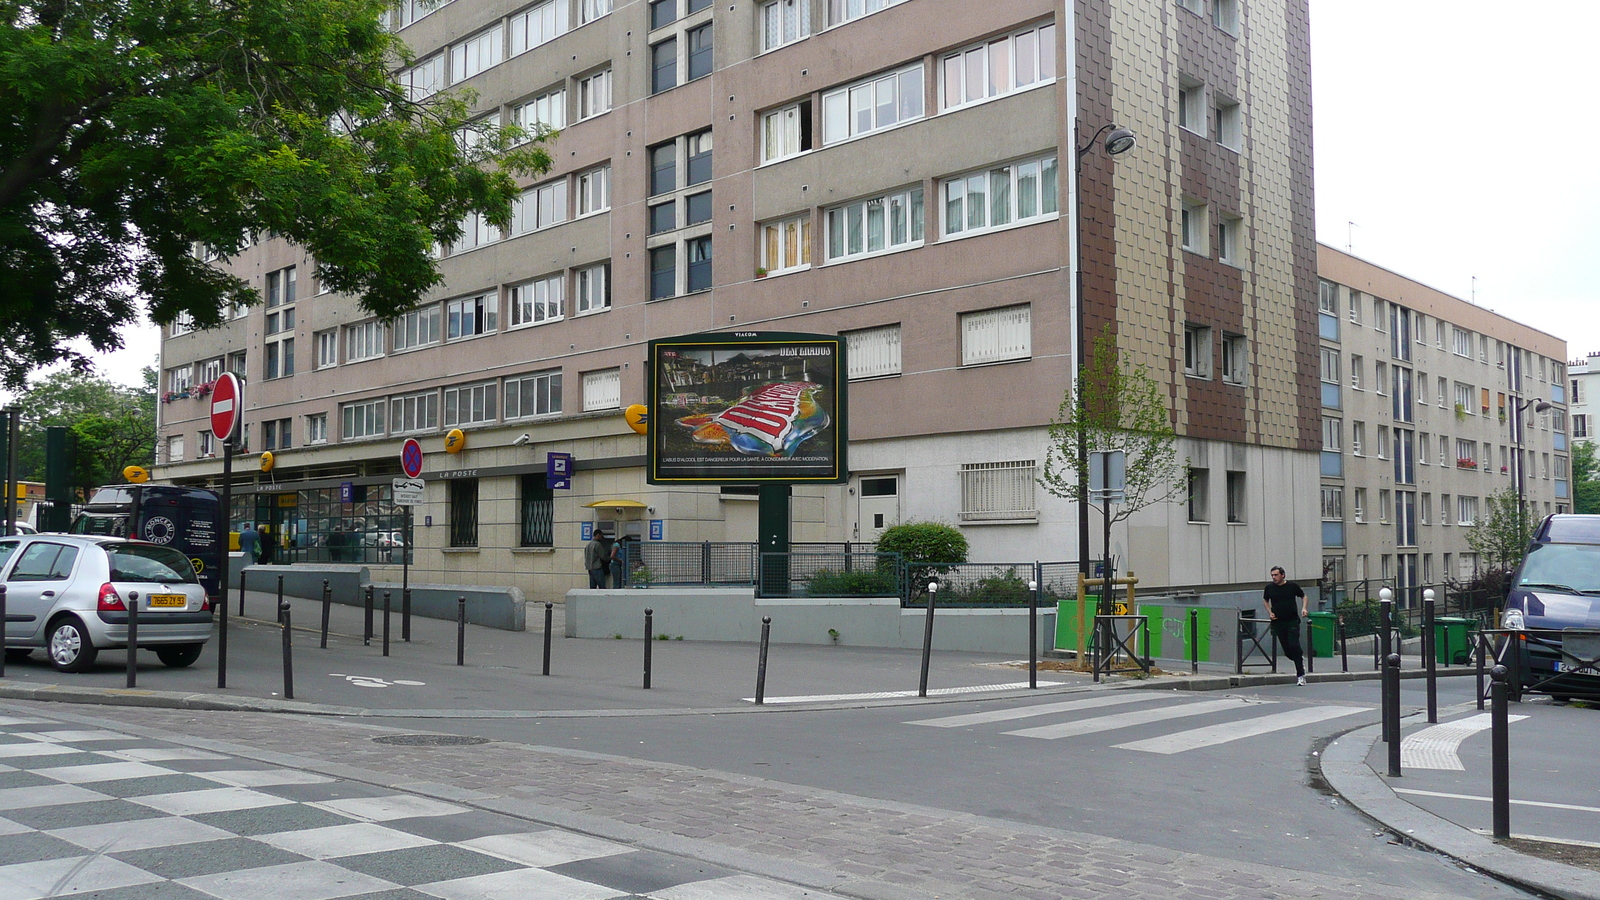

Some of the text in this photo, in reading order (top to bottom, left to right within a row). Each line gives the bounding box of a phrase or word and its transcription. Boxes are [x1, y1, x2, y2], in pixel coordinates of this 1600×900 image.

[146, 517, 174, 533] MONCEAU
[147, 533, 172, 544] FLEURS
[153, 596, 168, 605] 7665
[169, 596, 177, 605] ZY
[177, 595, 185, 605] 93
